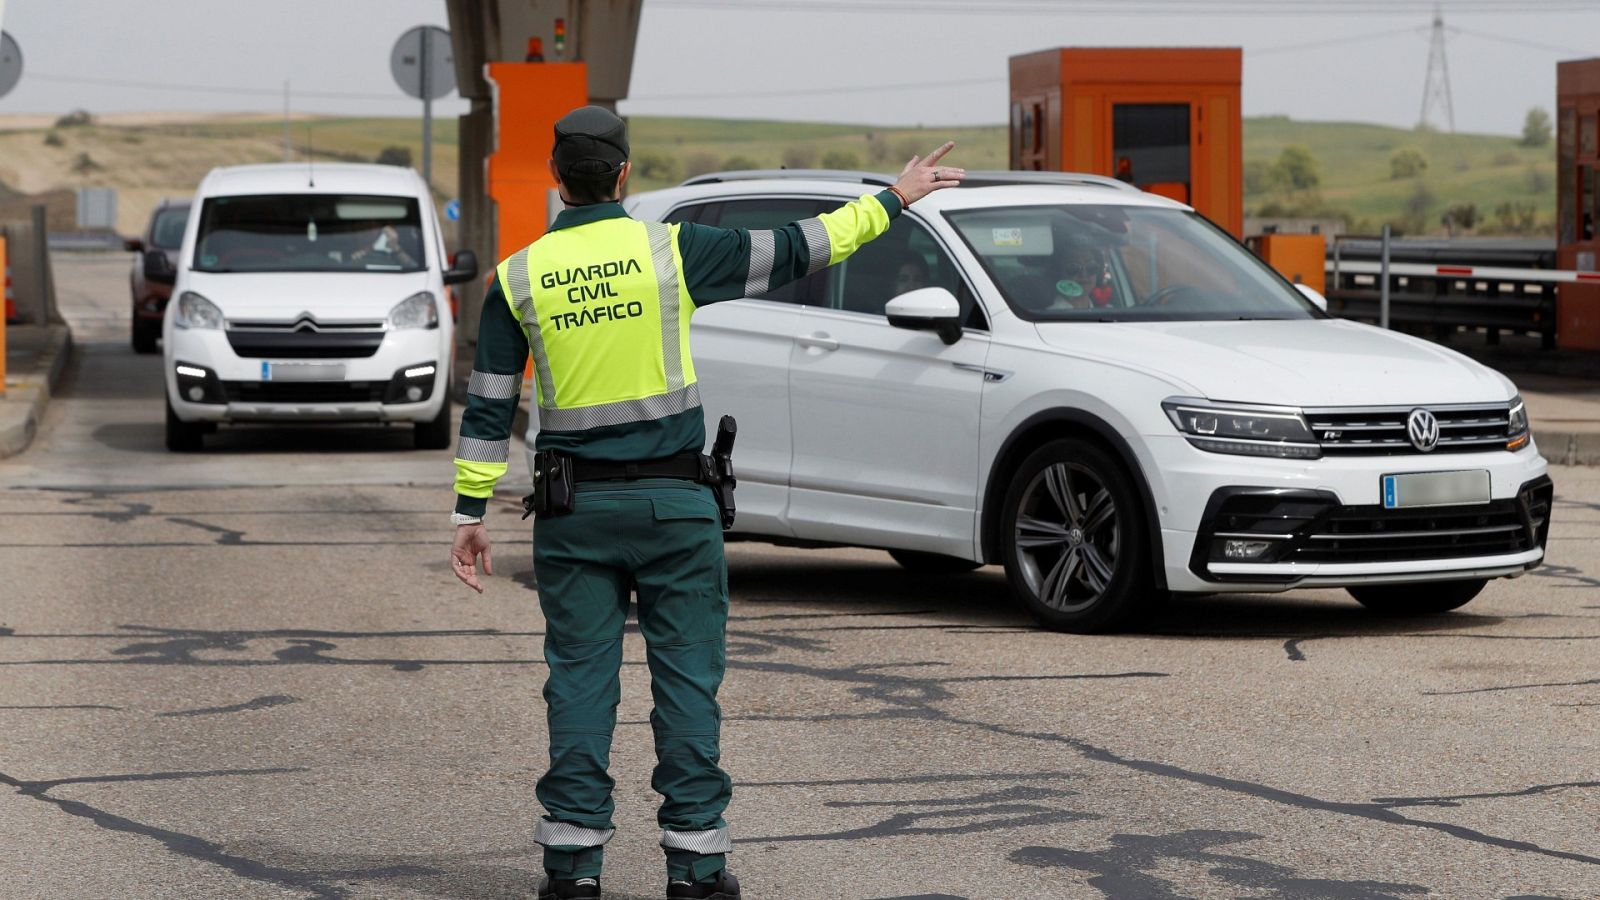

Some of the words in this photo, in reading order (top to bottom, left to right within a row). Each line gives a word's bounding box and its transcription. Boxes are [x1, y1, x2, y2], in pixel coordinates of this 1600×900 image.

[541, 259, 642, 289] GUARDIA
[567, 282, 618, 304] CIVIL
[550, 301, 643, 331] TRÁFICO
